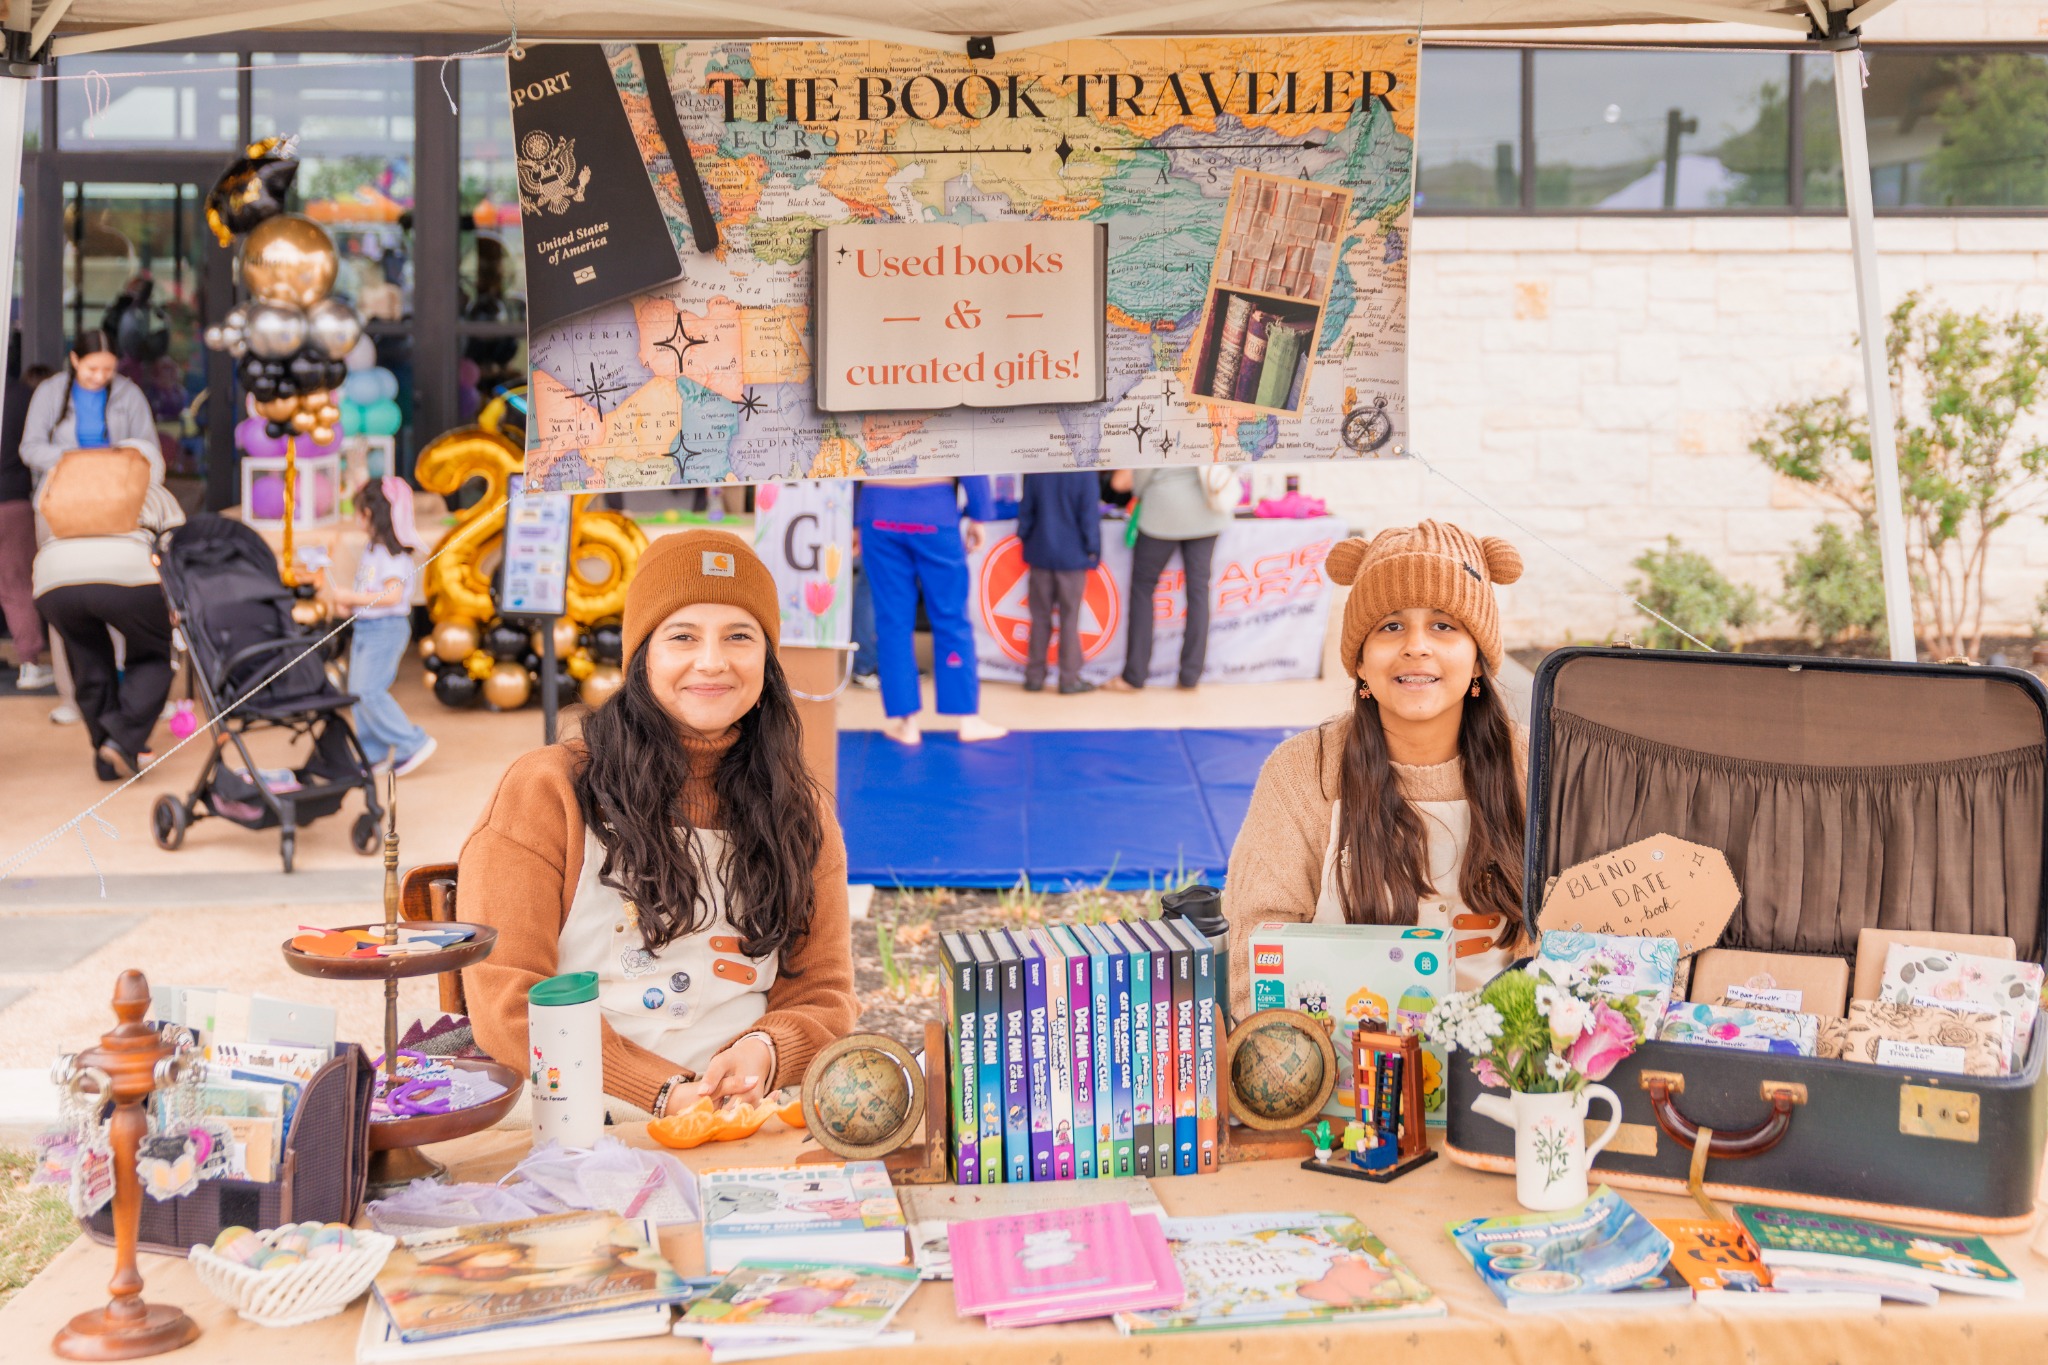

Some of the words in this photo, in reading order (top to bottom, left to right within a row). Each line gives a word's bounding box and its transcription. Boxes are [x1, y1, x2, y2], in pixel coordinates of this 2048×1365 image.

[864, 66, 888, 74] Nizhniy
[889, 66, 922, 74] Novgorod
[932, 67, 978, 75] Yekaterinburg
[511, 71, 572, 110] PORT
[708, 77, 841, 122] THE
[856, 73, 1047, 120] BOOK
[1061, 70, 1398, 117] TRAVELER
[733, 128, 897, 149] EUROPE
[698, 161, 731, 169] Budapest
[1192, 156, 1300, 166] MONGOLIA
[1154, 165, 1310, 185] ASA
[786, 198, 809, 207] Black
[811, 198, 826, 207] Sea
[900, 185, 914, 218] Caspian
[948, 194, 1003, 202] UZBEKISTAN
[537, 230, 575, 254] United
[576, 221, 609, 240] States
[548, 249, 560, 266] of
[562, 236, 608, 260] America
[856, 245, 945, 278] Used
[953, 243, 1064, 276] books
[736, 283, 761, 295] Sea
[1355, 287, 1383, 295] Shanghai
[944, 299, 982, 330] &
[1363, 310, 1386, 320] China
[1366, 302, 1383, 311] East
[1367, 319, 1381, 328] Sea
[549, 331, 633, 342] ALGERIA
[665, 333, 720, 343] LIBYA
[1355, 331, 1374, 339] Taipei
[750, 348, 800, 359] EGYPT
[846, 351, 985, 386] curated
[993, 350, 1080, 389] gifts!
[1125, 361, 1150, 369] Kolkata
[1311, 403, 1335, 413] South
[551, 424, 595, 433] MALI
[613, 420, 677, 431] NIGER
[892, 419, 924, 427] YEMEN
[990, 415, 1005, 424] Sea
[1310, 416, 1335, 425] China
[682, 432, 726, 441] CHAD
[747, 438, 801, 448] SUDAN
[908, 437, 923, 448] Aden
[1103, 429, 1131, 437] (Madras)
[1315, 428, 1329, 437] Sea
[1275, 442, 1285, 450] Chi
[1303, 441, 1316, 451] City
[553, 454, 588, 463] BURKINA
[585, 478, 606, 486] BENIN
[784, 513, 821, 572] G
[1153, 568, 1324, 620] BRRA
[1611, 871, 1671, 908] DATE
[1623, 916, 1632, 924] a
[1640, 897, 1681, 923] book
[1256, 953, 1282, 966] LEGO
[1257, 983, 1271, 994] 7+
[1056, 996, 1066, 1017] CAT
[1096, 993, 1107, 1014] CAT
[1119, 991, 1129, 1012] CAT
[1198, 997, 1213, 1024] DOG
[1007, 1009, 1023, 1037] DOG
[1031, 1006, 1046, 1034] DOG
[1075, 1006, 1089, 1033] DOG
[1134, 1001, 1149, 1029] DOG
[1154, 1000, 1170, 1028] DOG
[1178, 999, 1193, 1027] DOG
[960, 1011, 976, 1039] DOG
[983, 1012, 998, 1039] DOG
[1031, 1034, 1047, 1059] MAN
[1075, 1033, 1089, 1059] MAN
[1135, 1029, 1149, 1054] MAN
[1155, 1028, 1170, 1053] MAN
[1178, 1027, 1192, 1052] MAN
[1199, 1025, 1213, 1049] MAN
[960, 1040, 976, 1065] MAN
[983, 1040, 998, 1065] MAN
[1007, 1037, 1023, 1063] MAN
[1098, 1066, 1109, 1092] CLUB
[1121, 1063, 1131, 1089] CLUB
